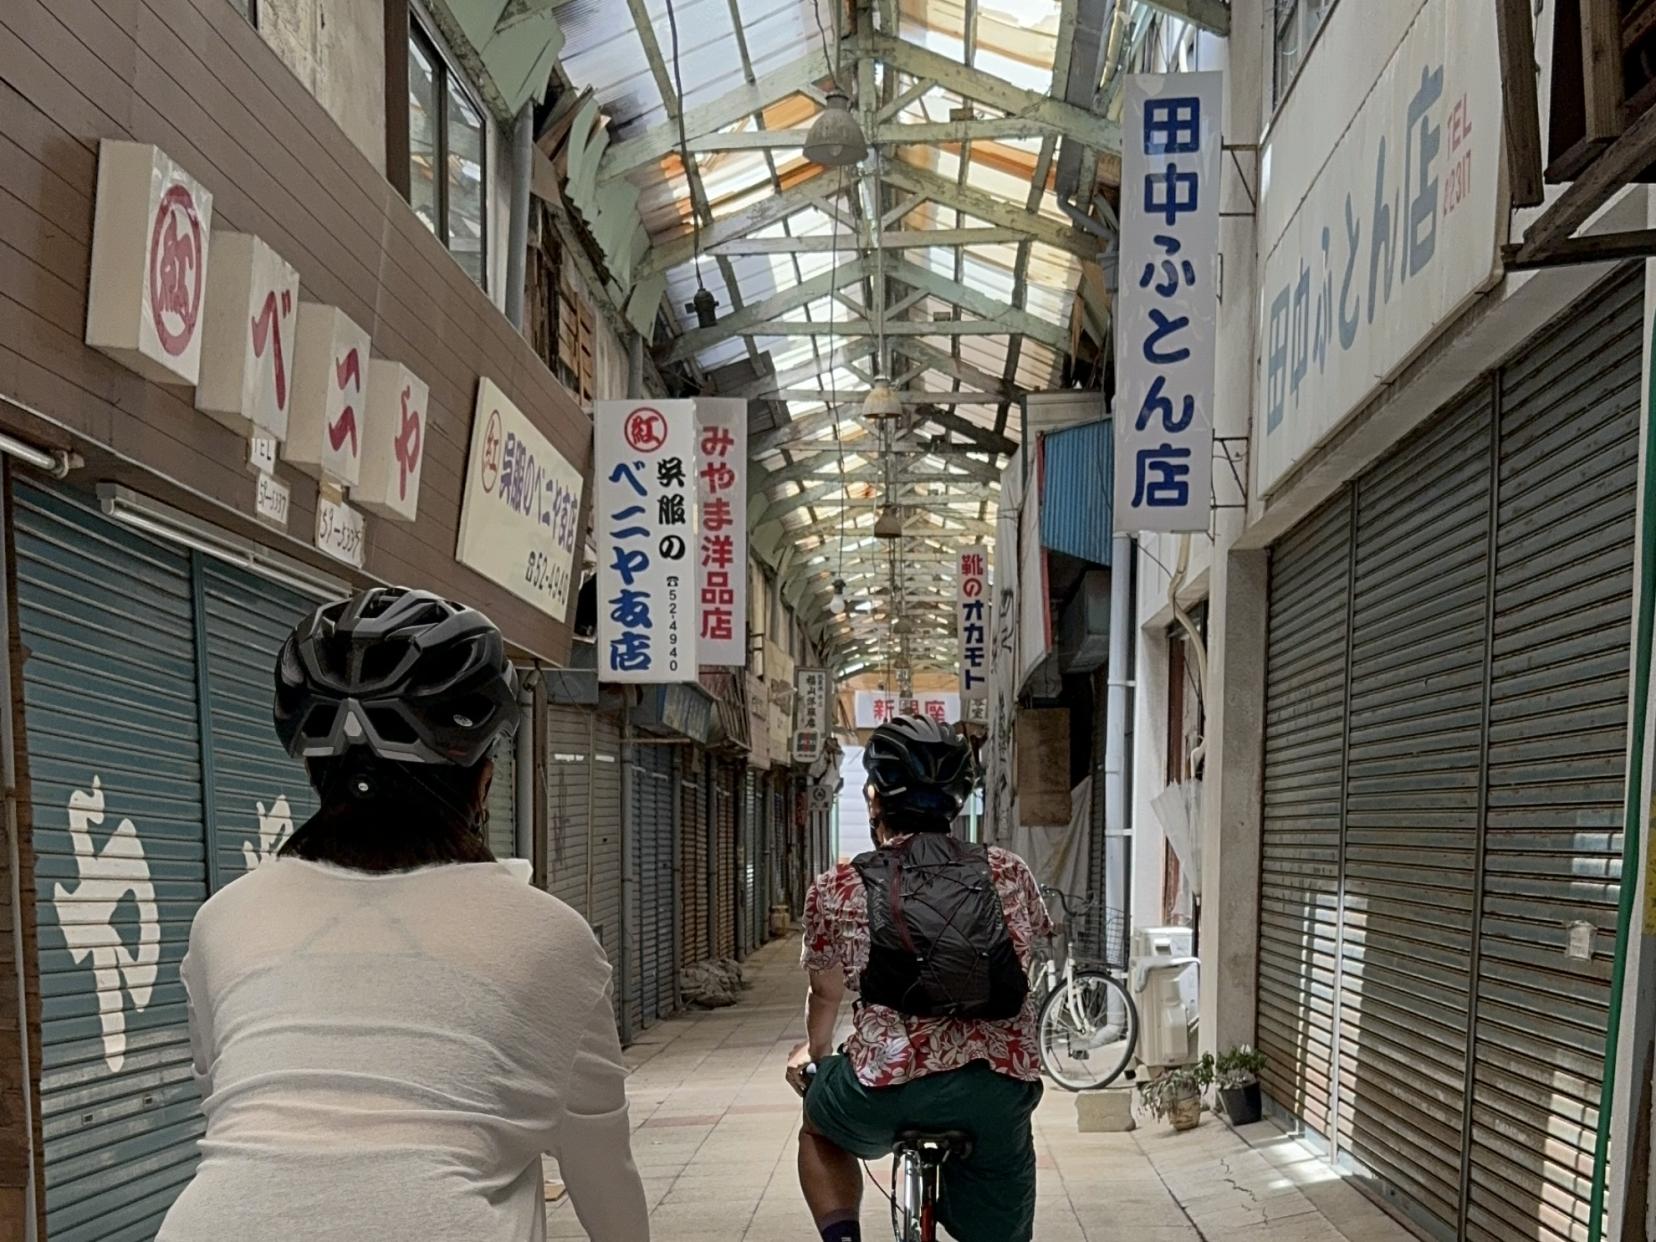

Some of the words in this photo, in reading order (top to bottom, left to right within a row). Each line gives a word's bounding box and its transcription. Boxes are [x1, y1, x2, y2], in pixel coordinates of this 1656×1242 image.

[1447, 93, 1472, 160] TEL
[1131, 96, 1200, 509] 田中ふとん店
[1266, 64, 1444, 437] 田中ふとん店
[657, 457, 686, 560] 呉服の
[700, 426, 735, 640] みやま洋品店
[668, 589, 679, 672] 52-4940
[961, 553, 985, 690] 靴のオカモト
